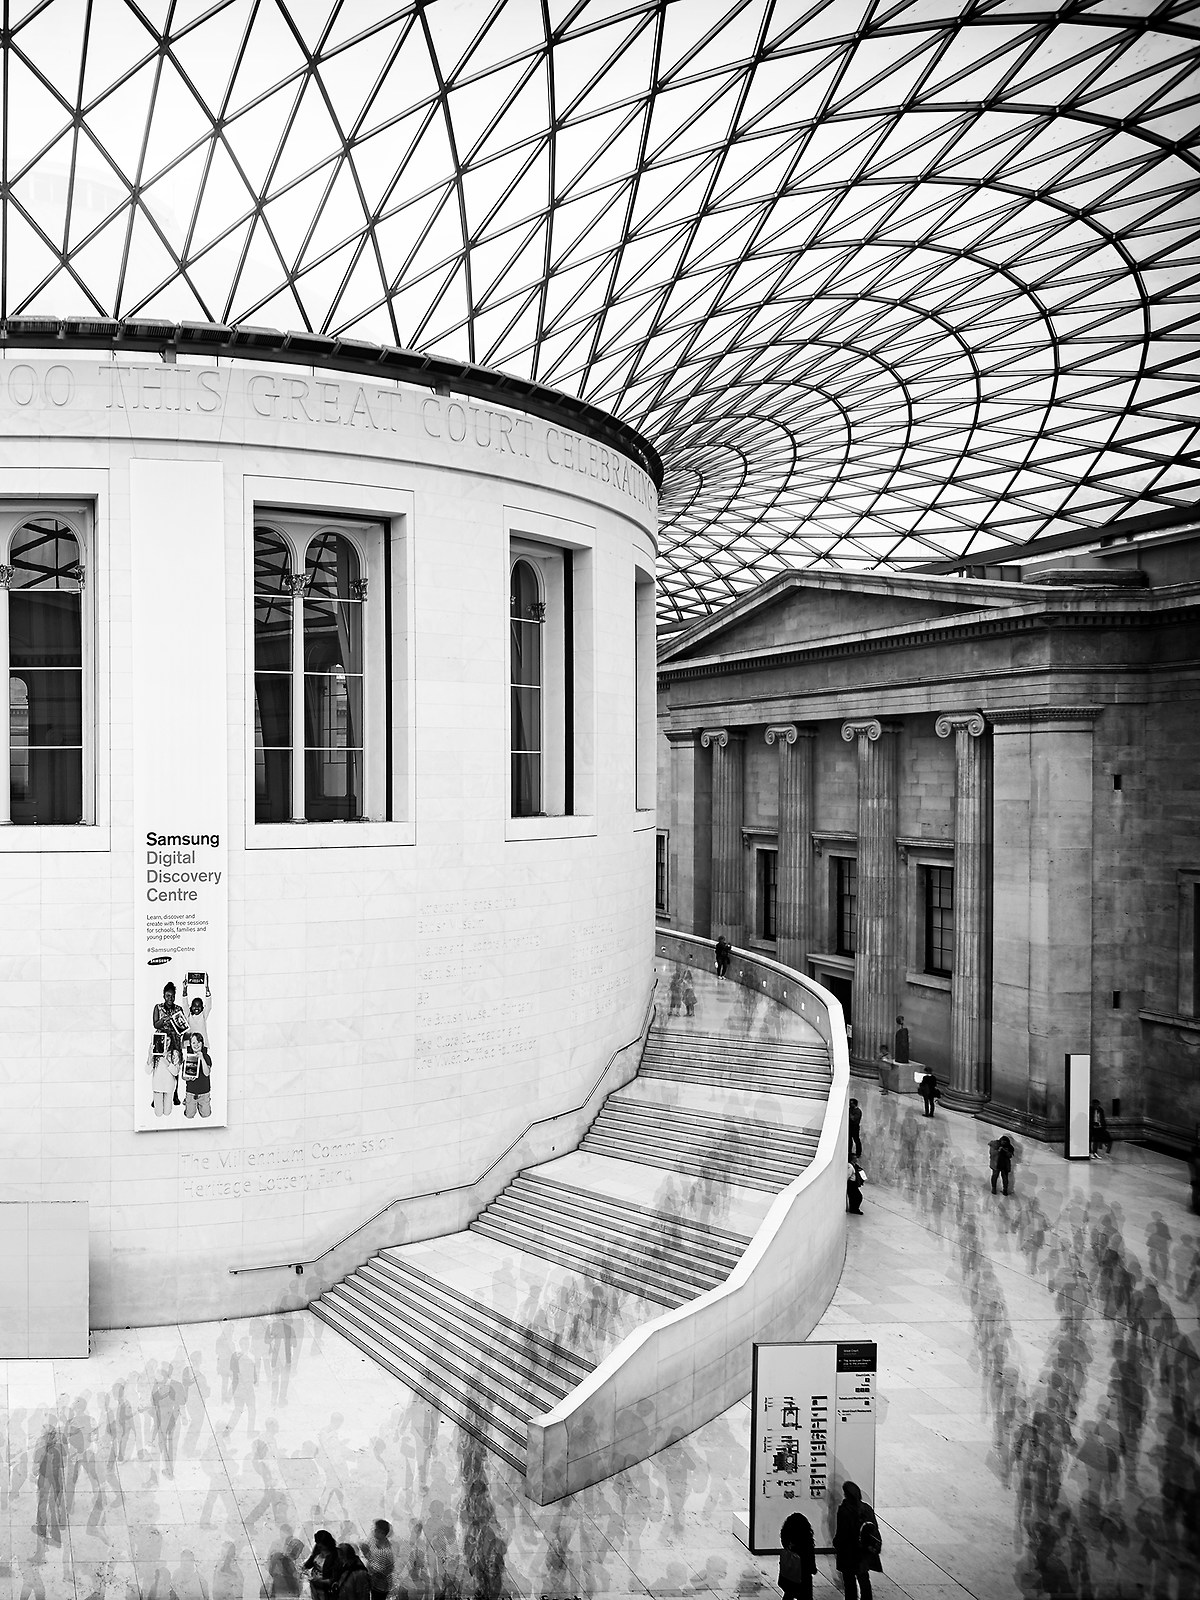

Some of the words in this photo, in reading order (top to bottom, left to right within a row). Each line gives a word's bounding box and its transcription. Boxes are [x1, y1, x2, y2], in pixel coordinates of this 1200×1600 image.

[98, 365, 222, 413] THIS
[246, 374, 403, 433] GREAT
[419, 397, 533, 459] COURT
[146, 832, 220, 848] Samsung
[147, 851, 196, 867] Digital
[147, 869, 222, 884] Discovery
[146, 887, 198, 902] Centre
[181, 1153, 209, 1170] The
